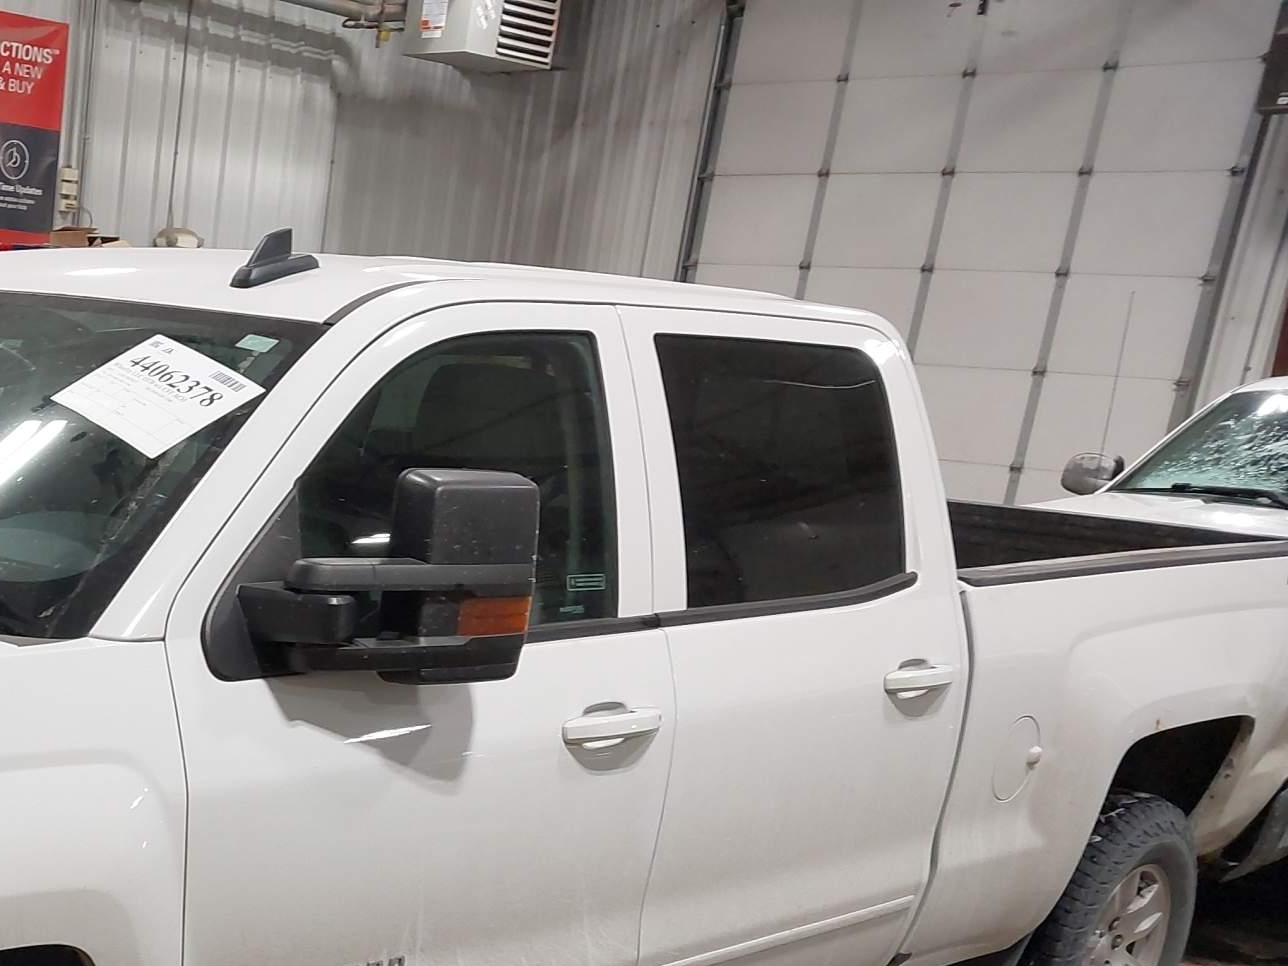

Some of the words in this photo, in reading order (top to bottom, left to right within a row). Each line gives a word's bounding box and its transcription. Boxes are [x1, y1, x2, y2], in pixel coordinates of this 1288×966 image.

[1, 61, 12, 75] A
[14, 62, 43, 79] NEW
[8, 78, 34, 94] BUY
[130, 355, 223, 407] 44062378
